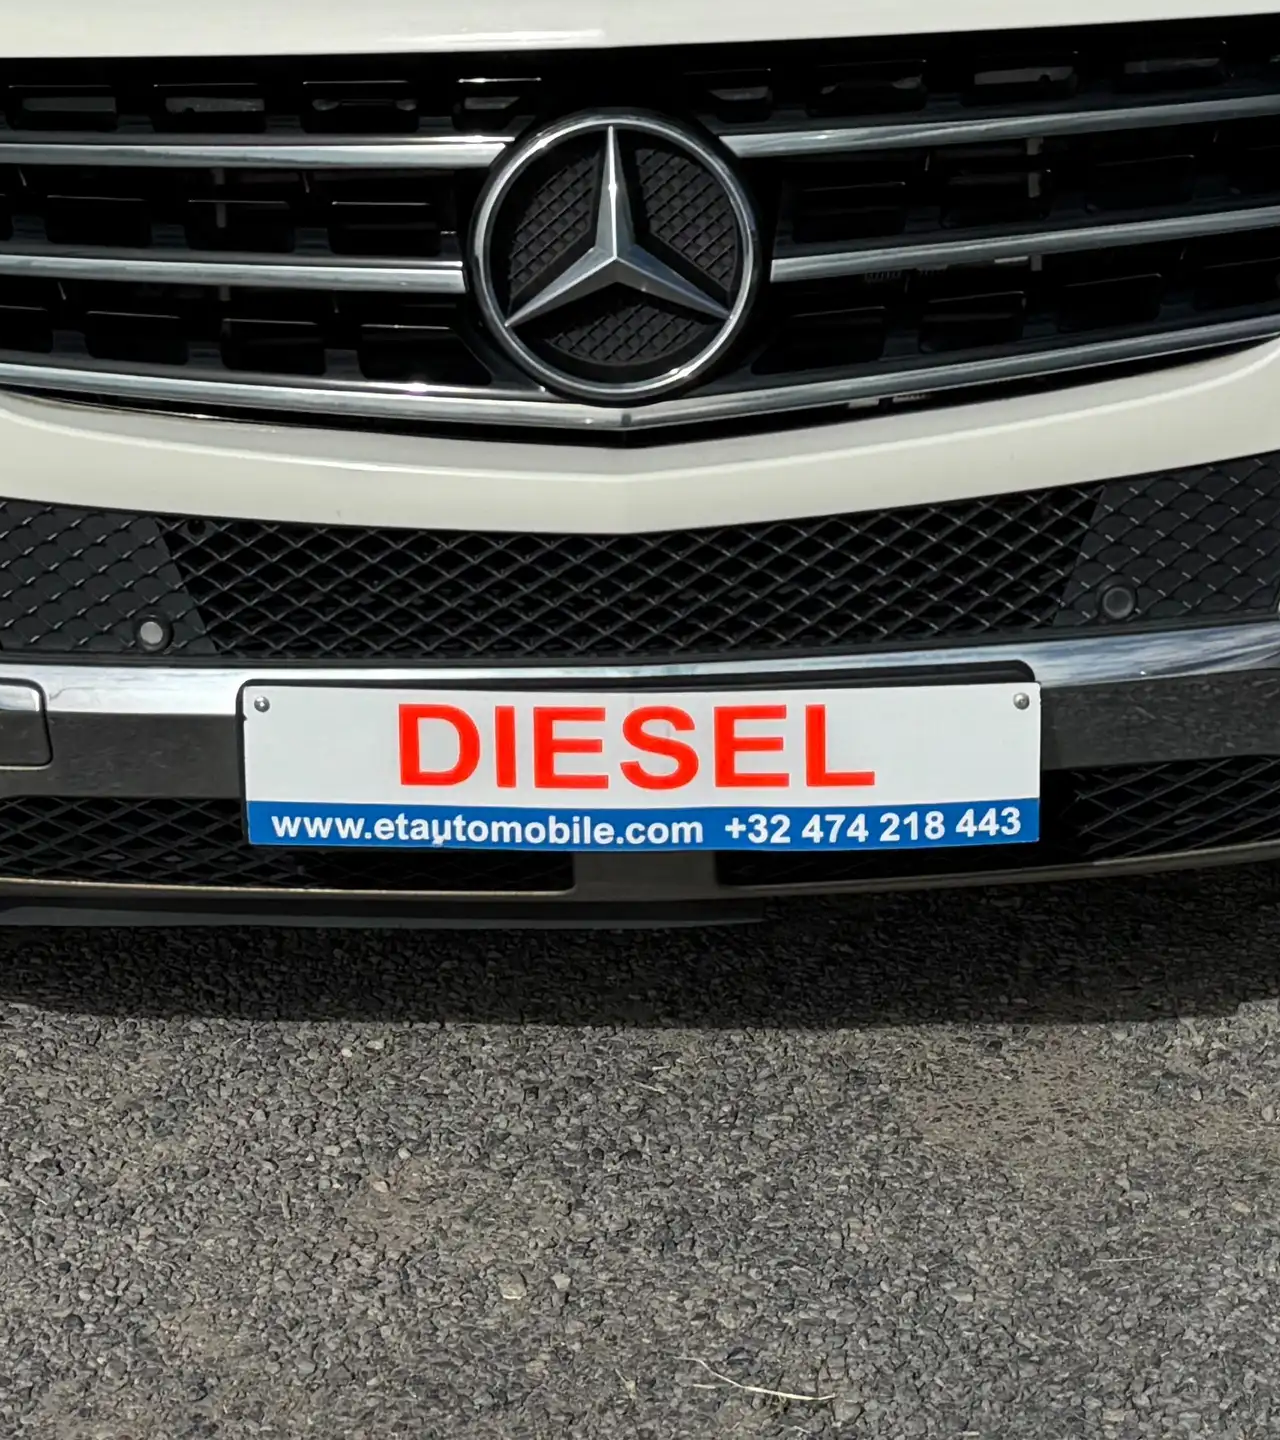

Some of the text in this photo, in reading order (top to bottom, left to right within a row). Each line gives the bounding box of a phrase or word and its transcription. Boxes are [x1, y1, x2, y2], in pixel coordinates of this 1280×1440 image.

[397, 703, 876, 790] DIESEL
[270, 806, 1022, 845] www.etautomobile.com +32 474 218 443
